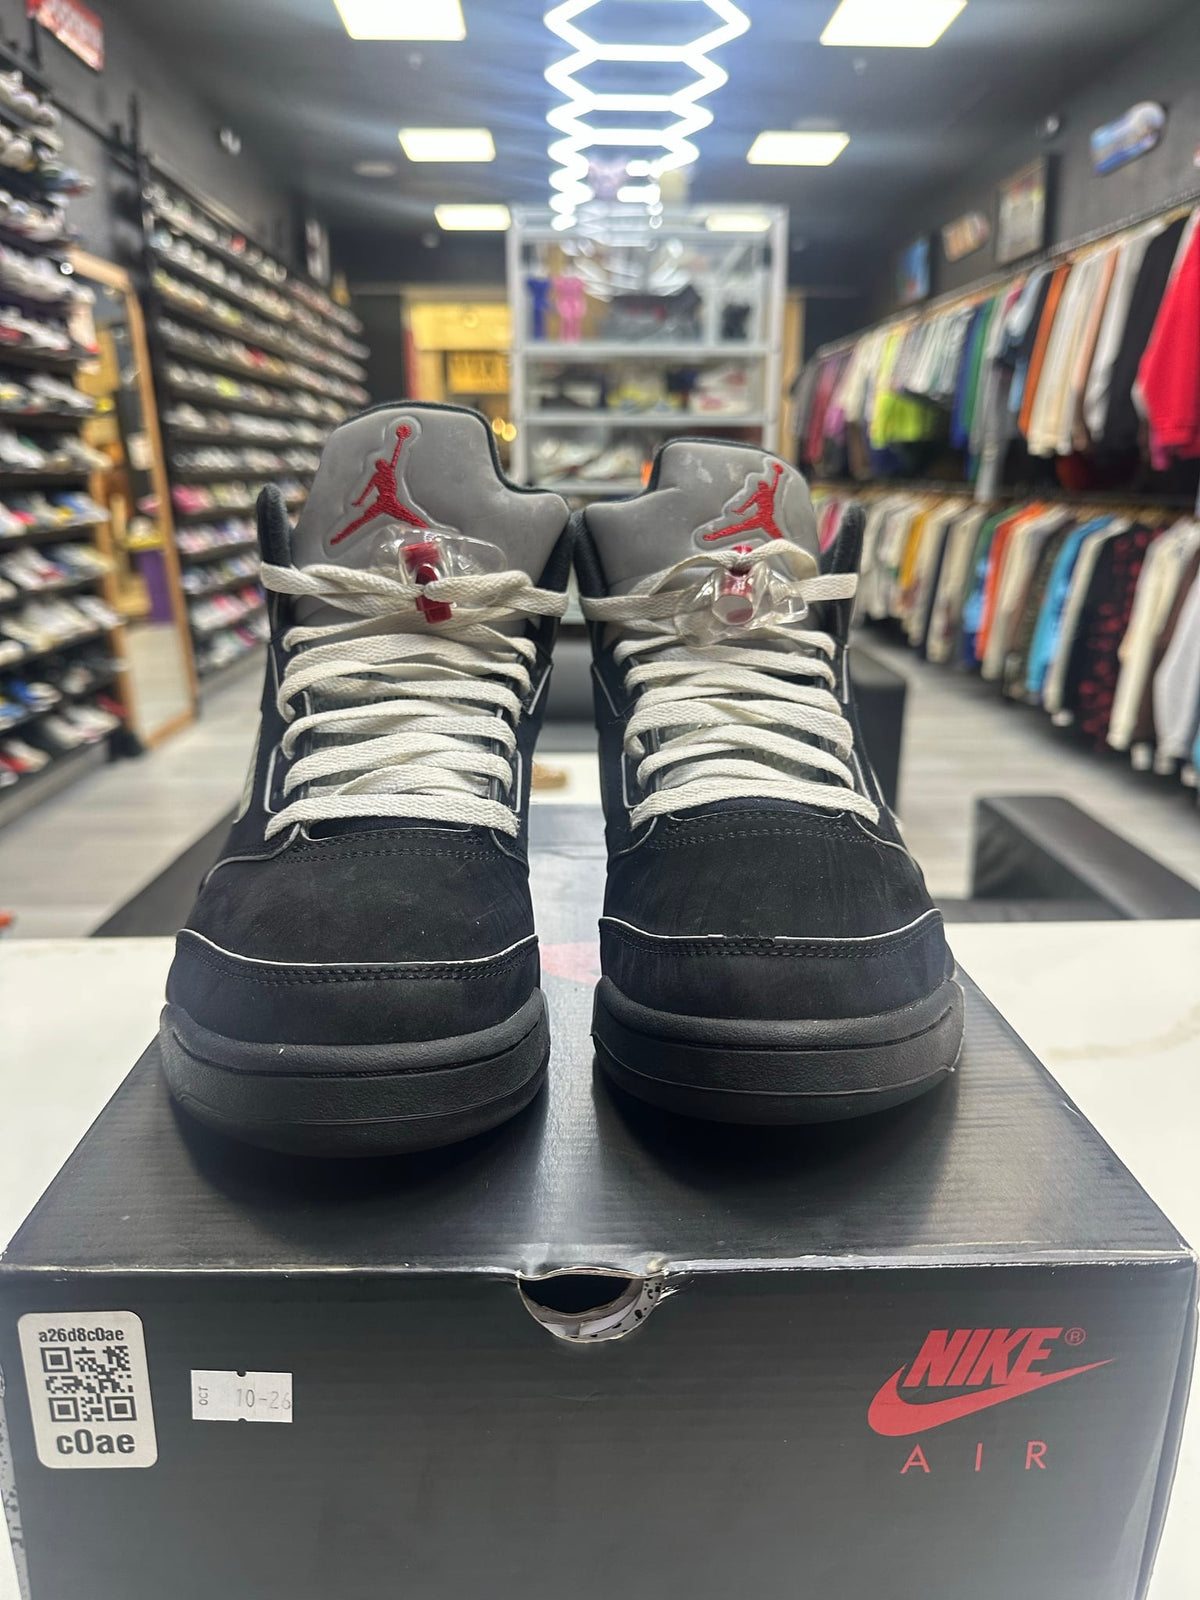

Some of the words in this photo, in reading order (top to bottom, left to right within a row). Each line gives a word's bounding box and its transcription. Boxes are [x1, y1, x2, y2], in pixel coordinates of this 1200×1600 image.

[38, 1327, 124, 1343] a26d8c0ae
[56, 1429, 136, 1455] c0ae
[900, 1440, 1047, 1474] AIR
